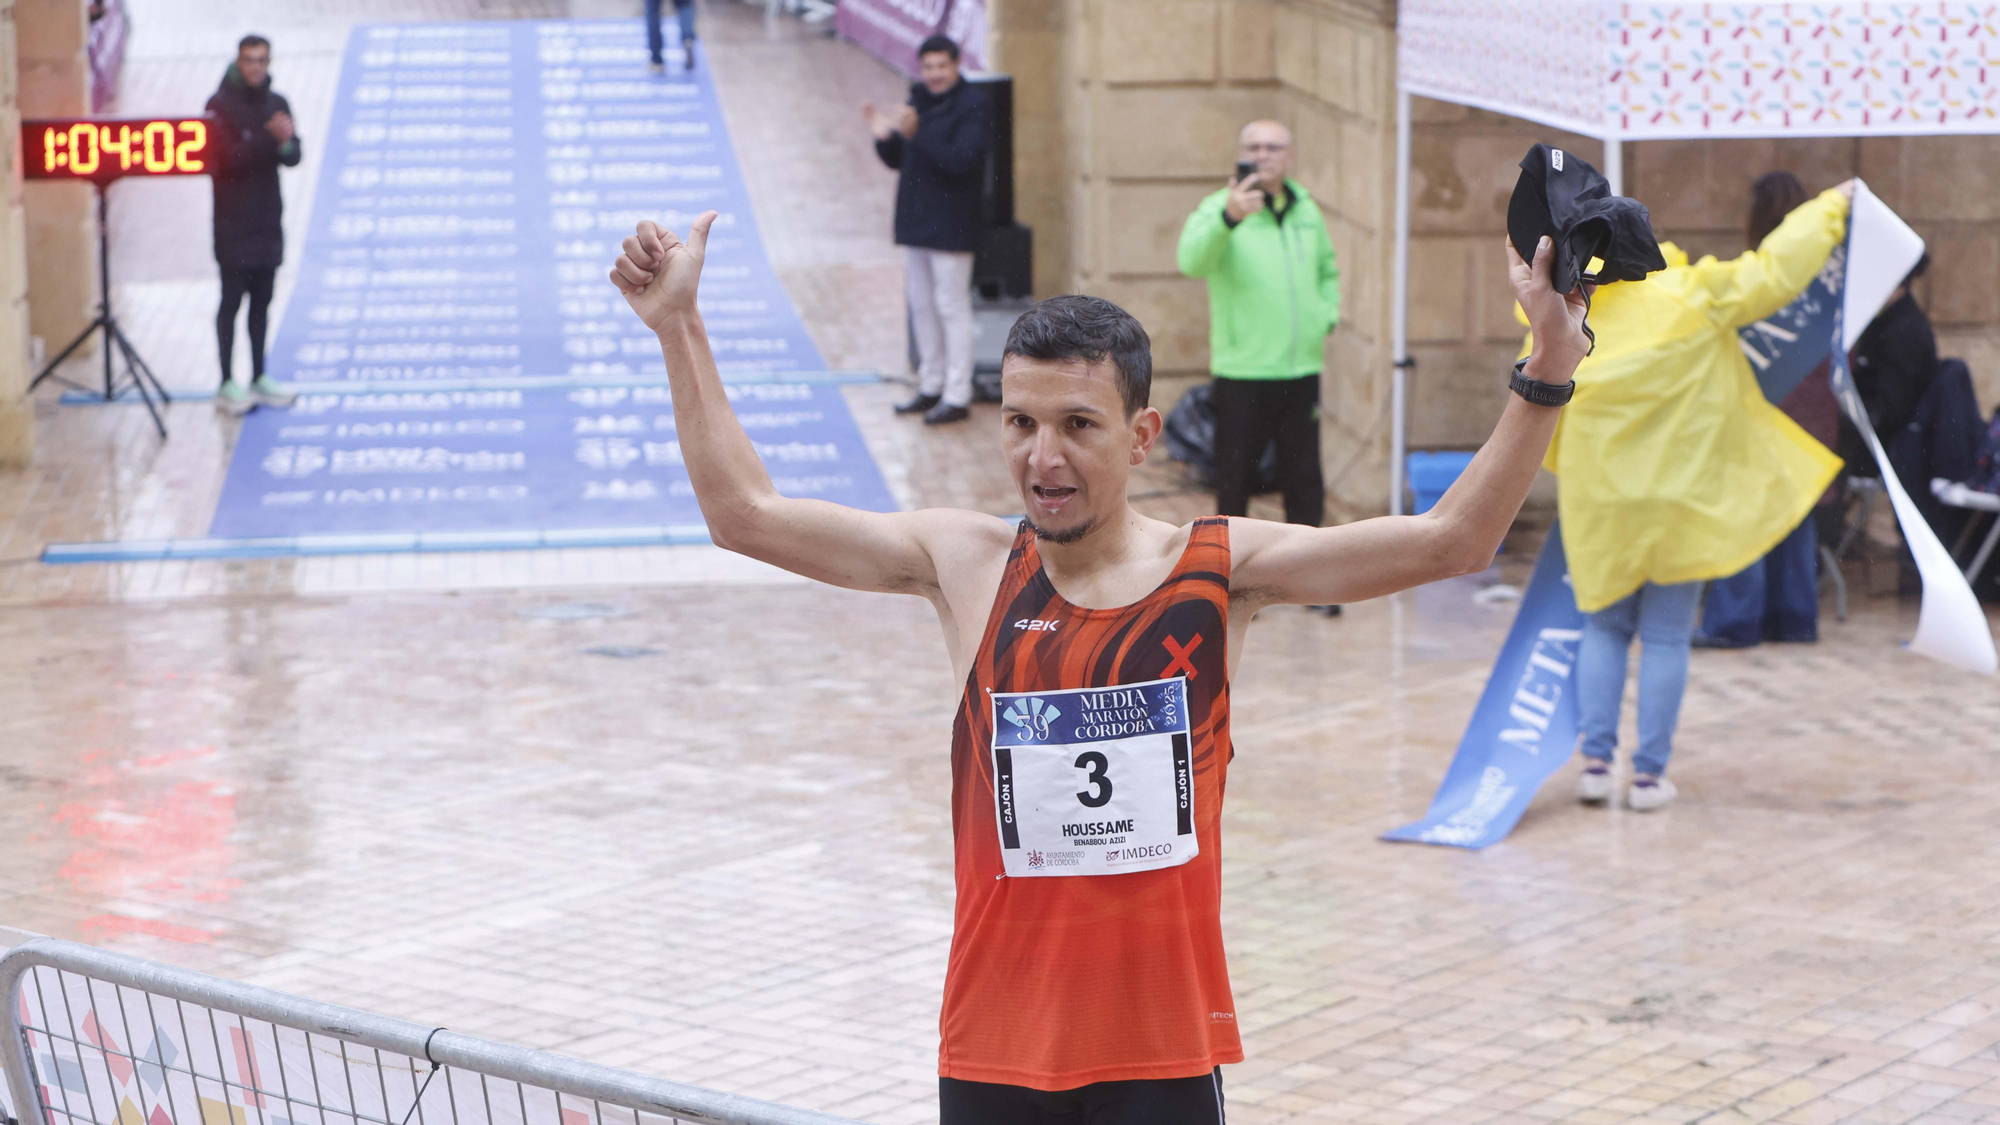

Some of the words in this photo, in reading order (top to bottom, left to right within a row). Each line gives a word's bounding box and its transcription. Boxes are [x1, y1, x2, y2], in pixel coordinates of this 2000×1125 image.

[44, 121, 207, 174] 1:04:02
[1013, 618, 1060, 632] 42K
[1080, 689, 1148, 711] MEDIA
[1500, 627, 1583, 755] META
[1082, 706, 1149, 725] MARATÓN
[1165, 686, 1178, 725] 2025
[1016, 713, 1050, 742] 39
[1075, 718, 1155, 740] CÓRDOBA
[1074, 751, 1113, 808] 3
[1177, 769, 1188, 810] CAJÓN
[1002, 784, 1014, 824] CAJÓN
[1062, 819, 1134, 837] HOUSSAME
[1074, 837, 1107, 847] BENABBOU
[1109, 836, 1126, 845] AZIZI
[1122, 843, 1172, 860] IMDECO
[1046, 851, 1085, 859] AYUNTAMIENTO
[1046, 859, 1053, 867] DE
